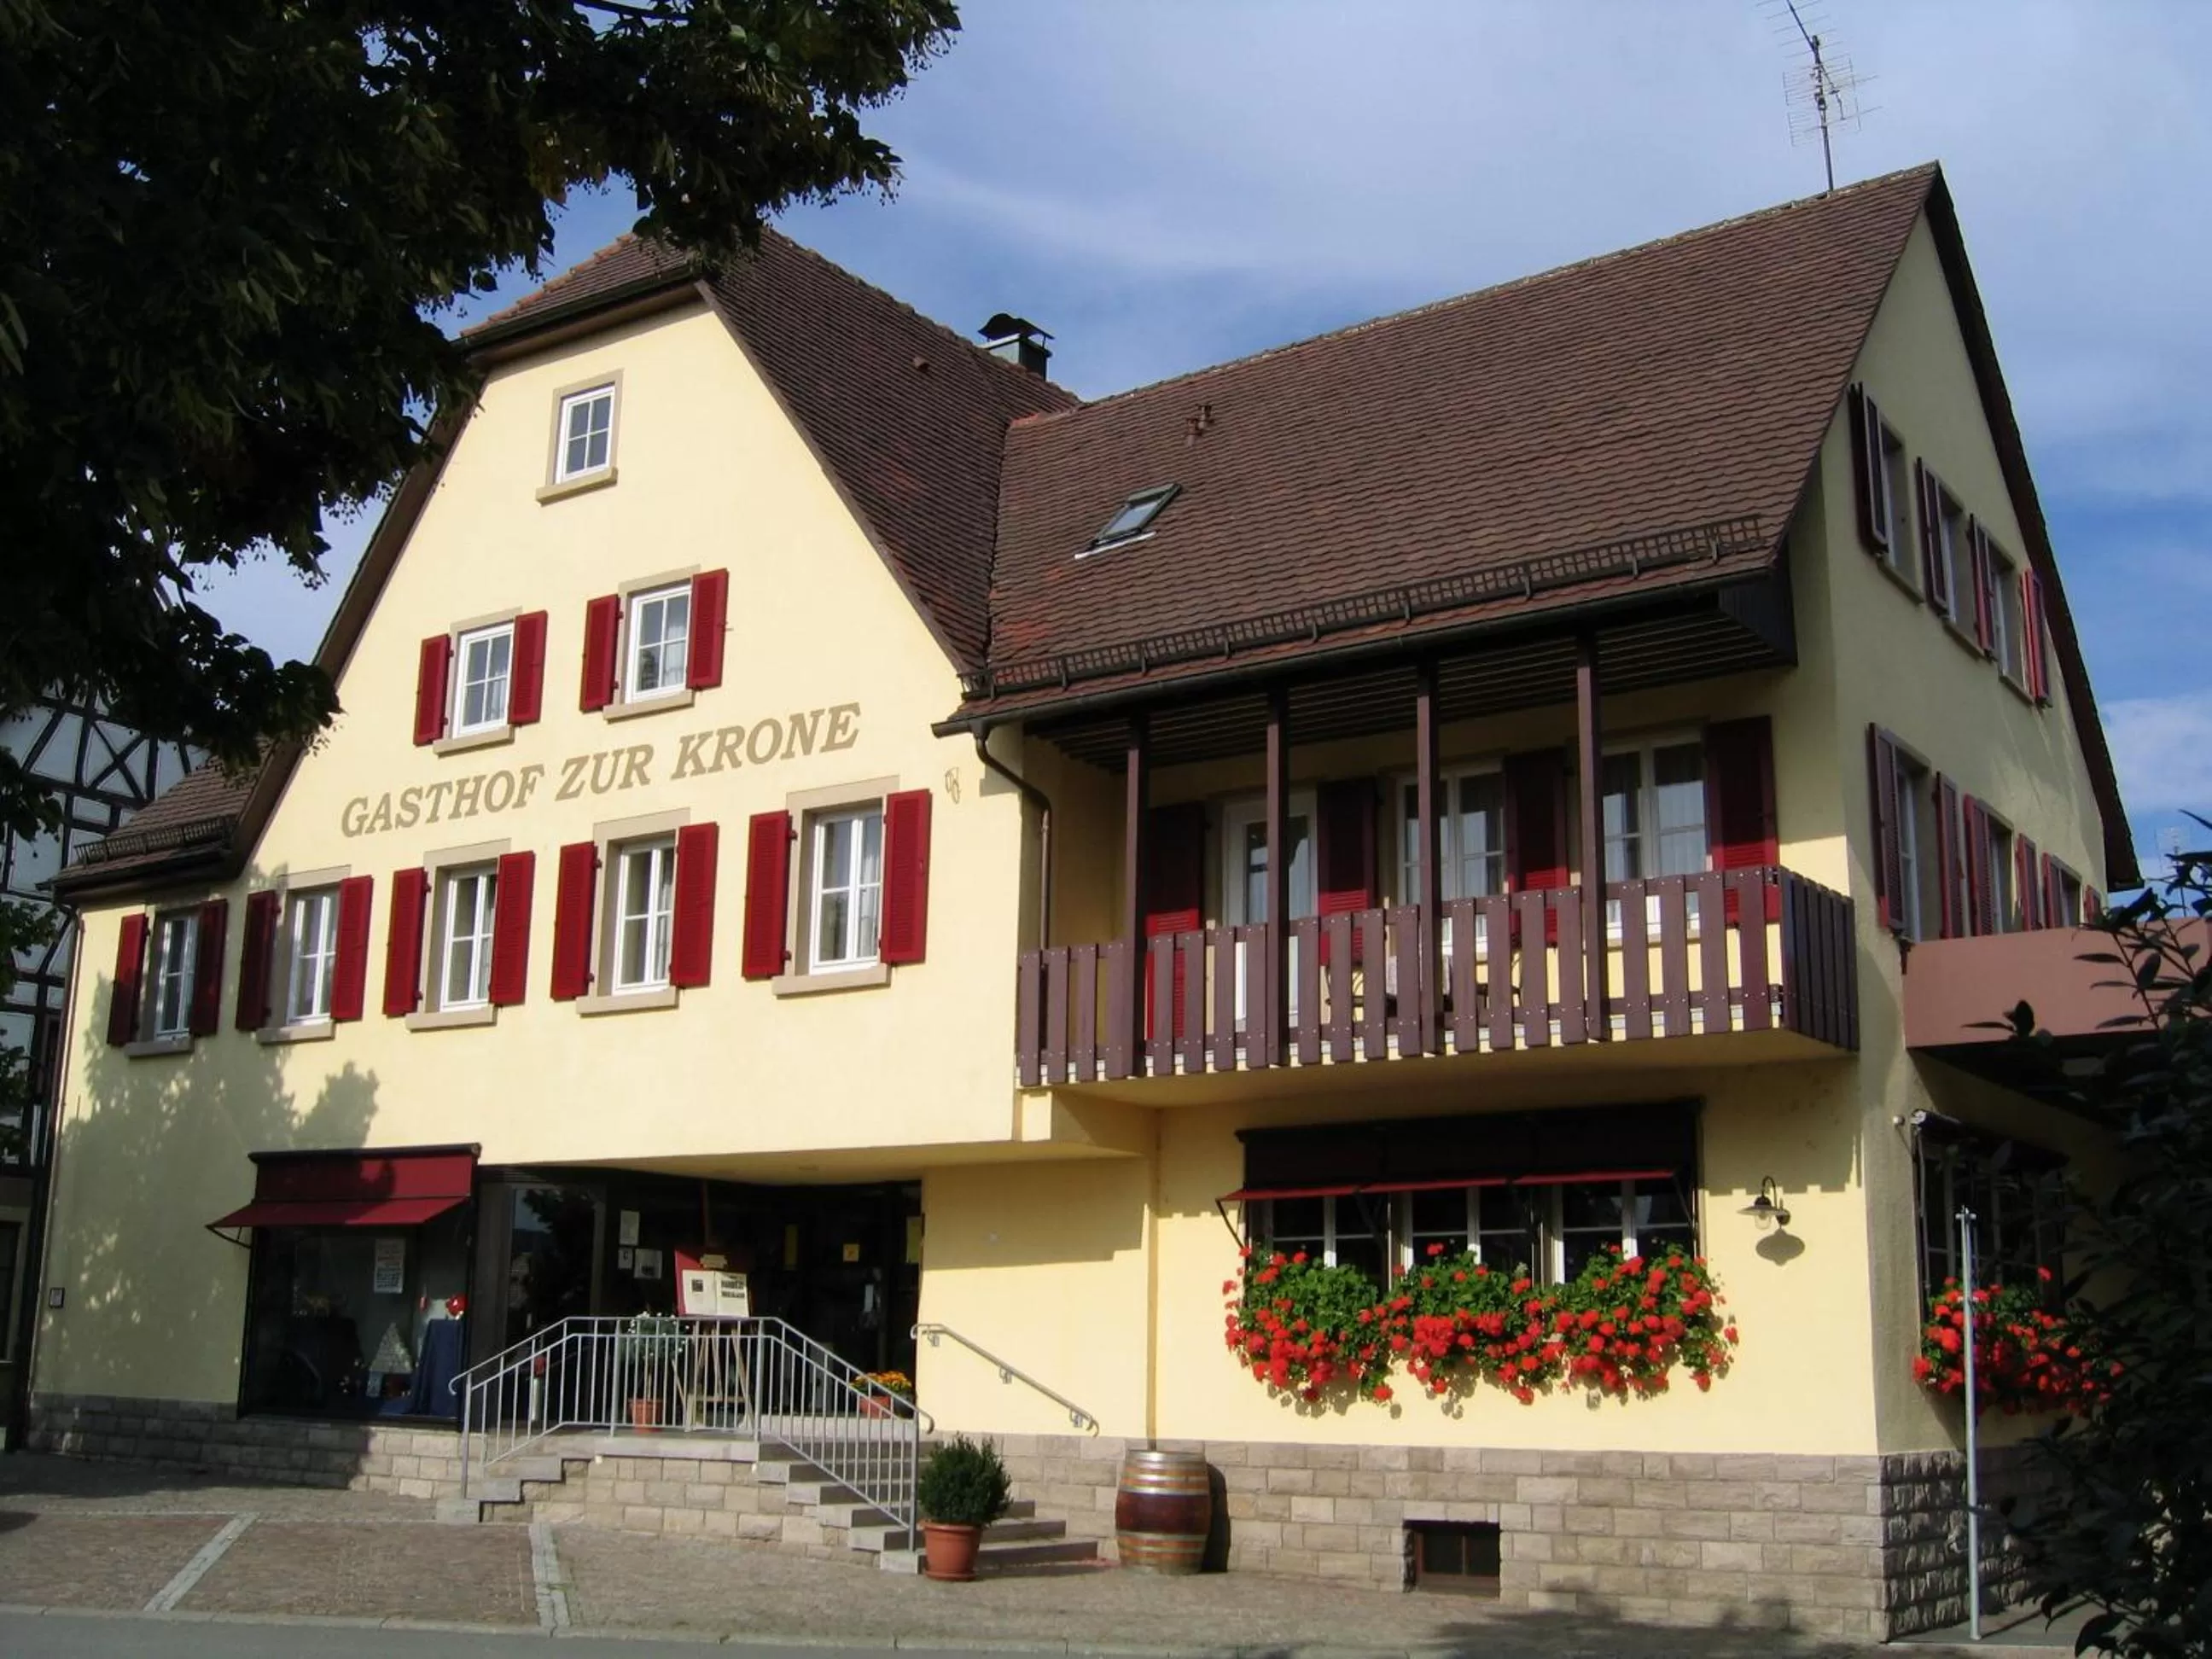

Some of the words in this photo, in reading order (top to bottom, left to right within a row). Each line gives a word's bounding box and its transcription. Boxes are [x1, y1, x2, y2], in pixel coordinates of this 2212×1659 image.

[341, 765, 544, 837] GASTHOF
[556, 743, 654, 801] ZUR
[672, 702, 861, 779] KRONE
